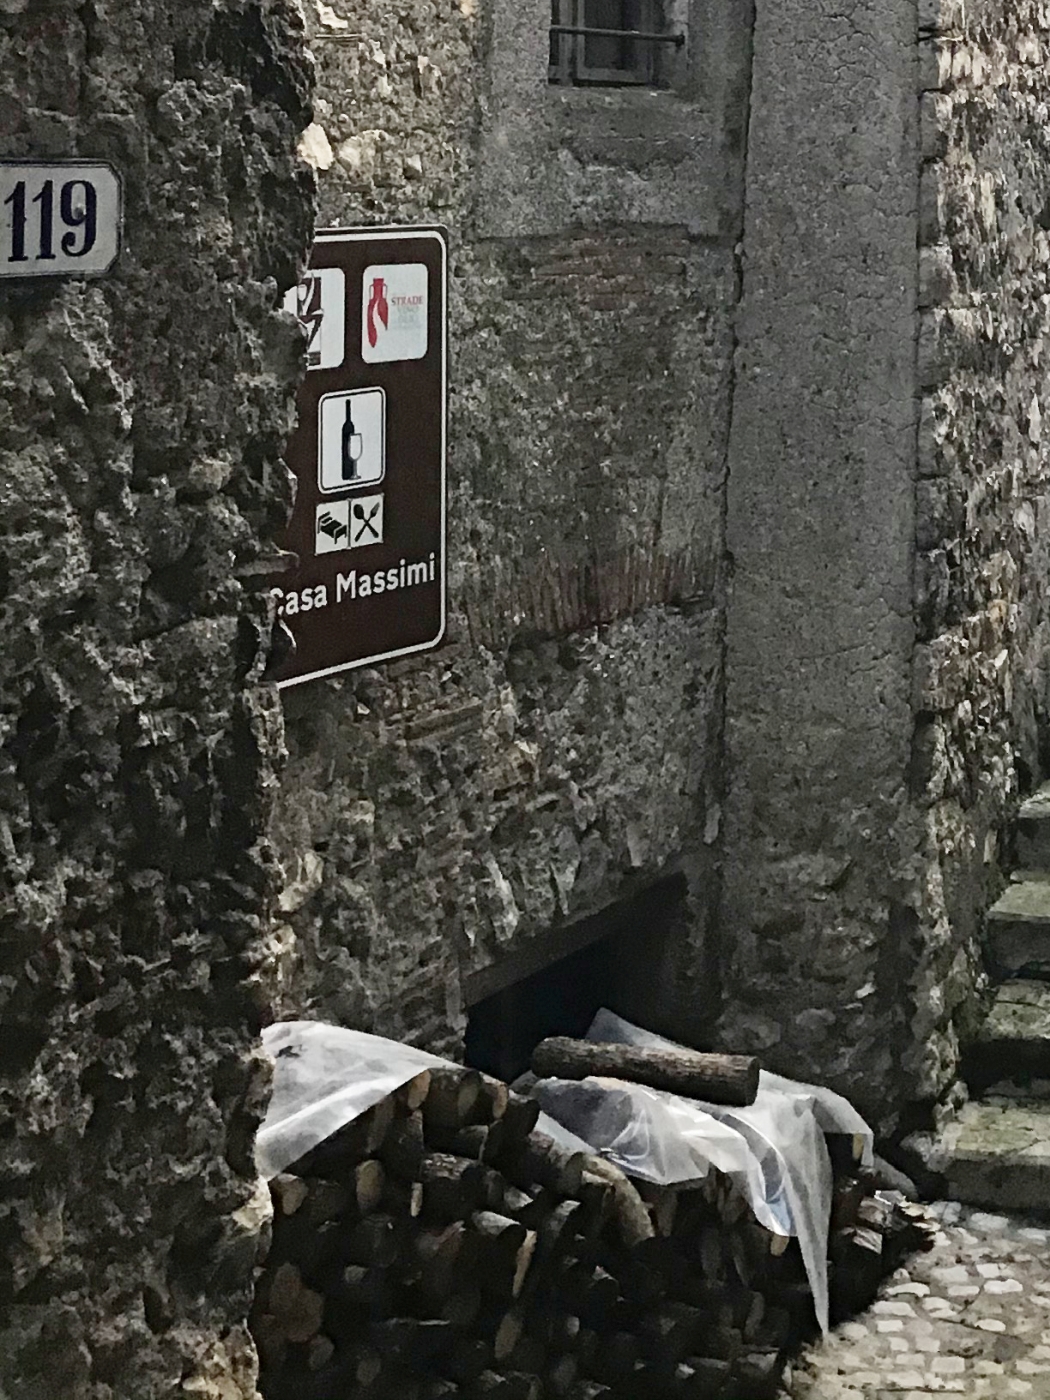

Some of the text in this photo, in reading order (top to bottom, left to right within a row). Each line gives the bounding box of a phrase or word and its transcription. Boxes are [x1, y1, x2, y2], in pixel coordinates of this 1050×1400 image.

[4, 180, 97, 262] 119
[391, 295, 424, 306] STRADE
[336, 552, 435, 603] Massimi
